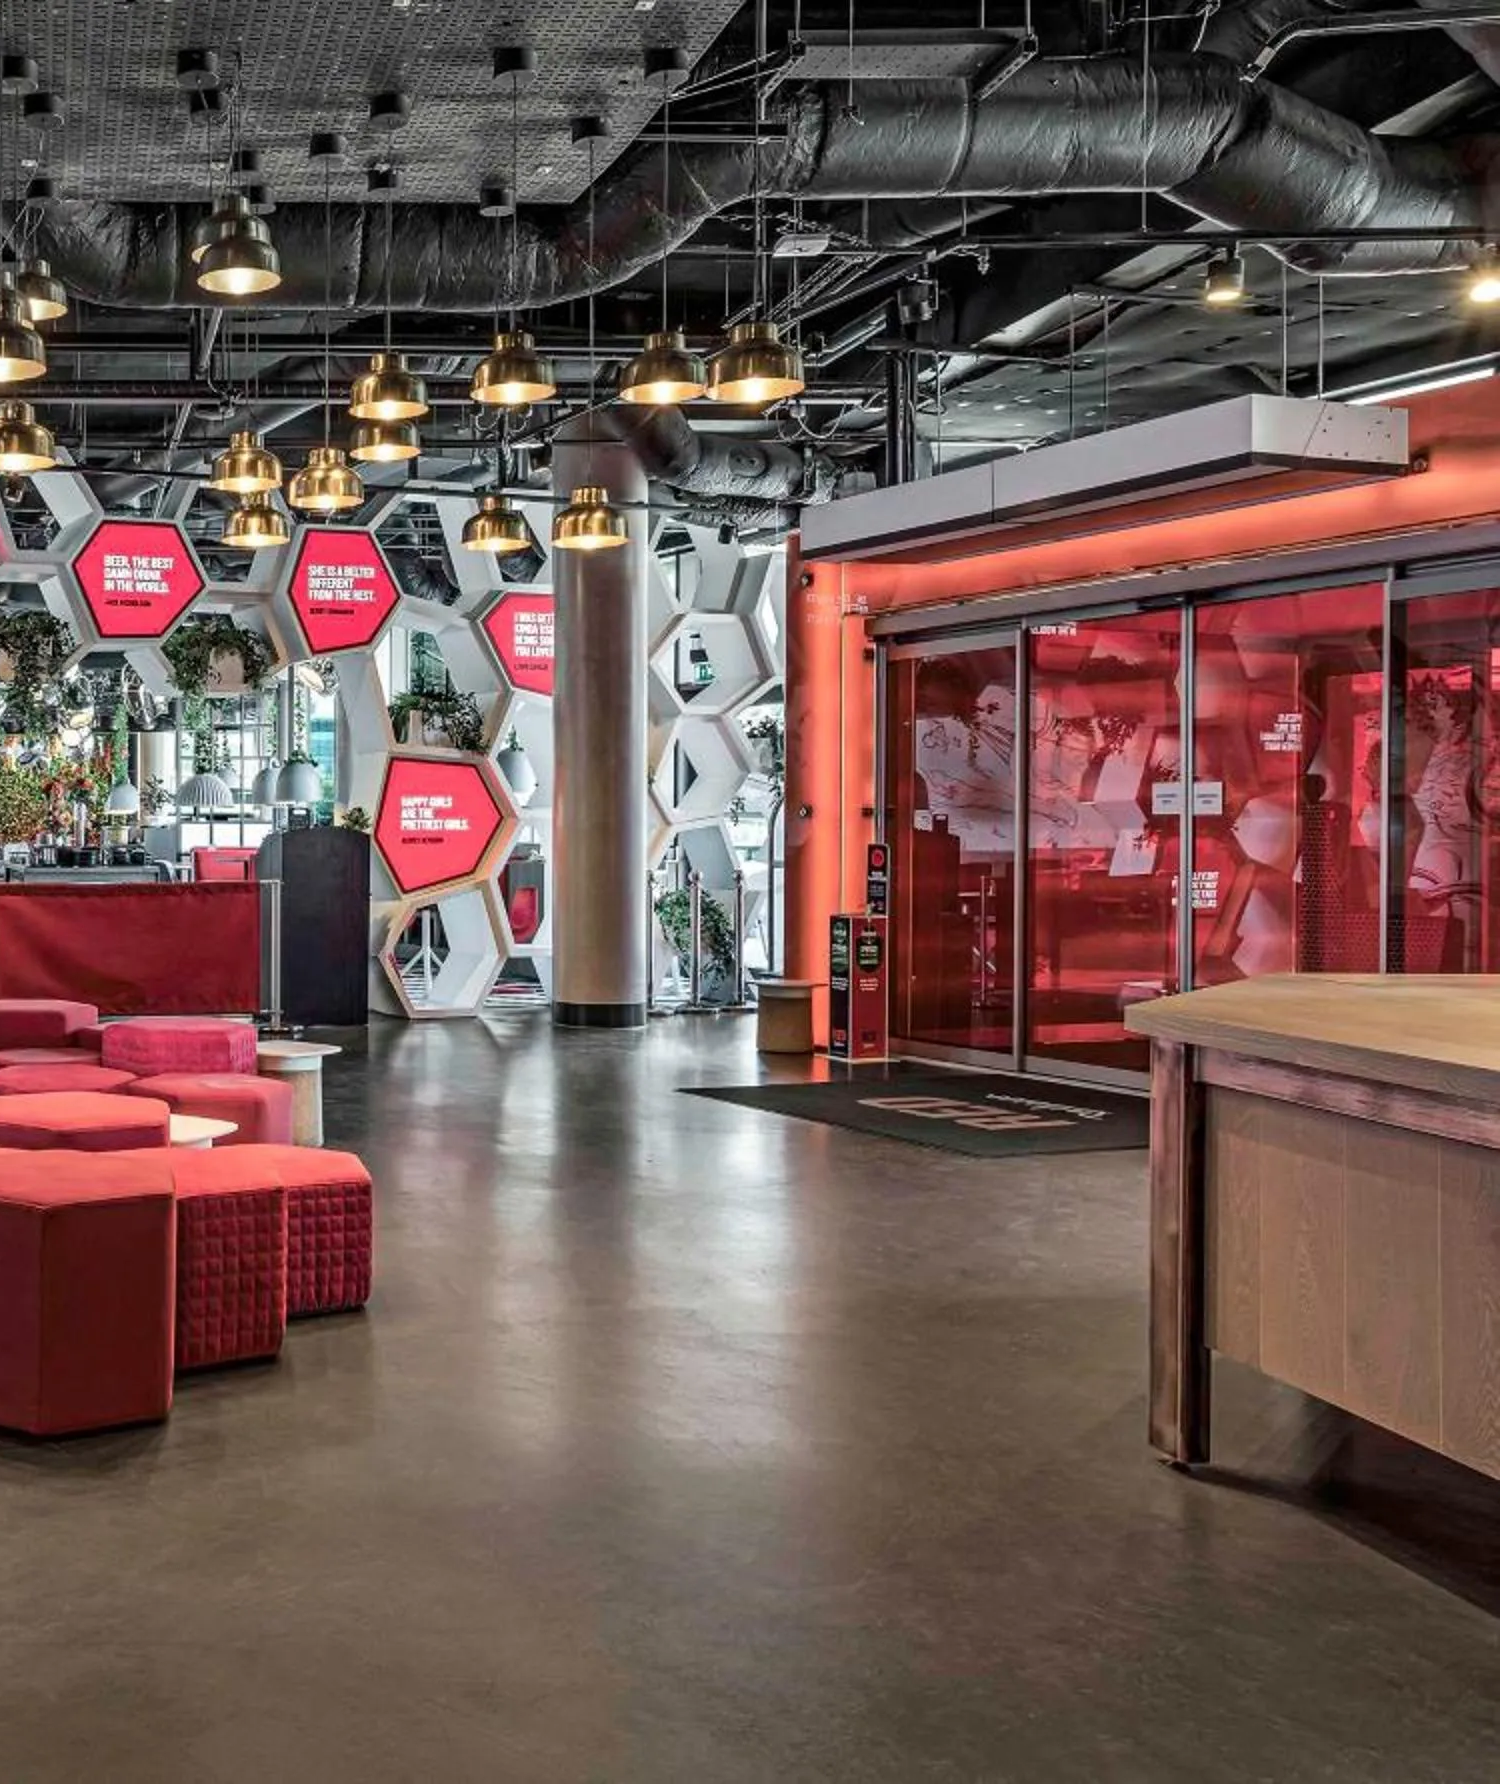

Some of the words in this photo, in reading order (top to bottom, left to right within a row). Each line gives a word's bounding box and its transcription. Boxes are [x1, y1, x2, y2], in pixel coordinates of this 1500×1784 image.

[131, 555, 150, 568] THE
[151, 557, 175, 570] BEST
[308, 565, 325, 577] SHE
[327, 565, 337, 577] IS
[104, 580, 116, 592] IN
[116, 580, 134, 593] THE
[308, 577, 355, 589] DIFFERENT
[308, 589, 333, 601] FROM
[334, 590, 351, 601] THE
[538, 612, 554, 625] GETT
[539, 624, 554, 635] USE
[531, 646, 554, 657] LOVE
